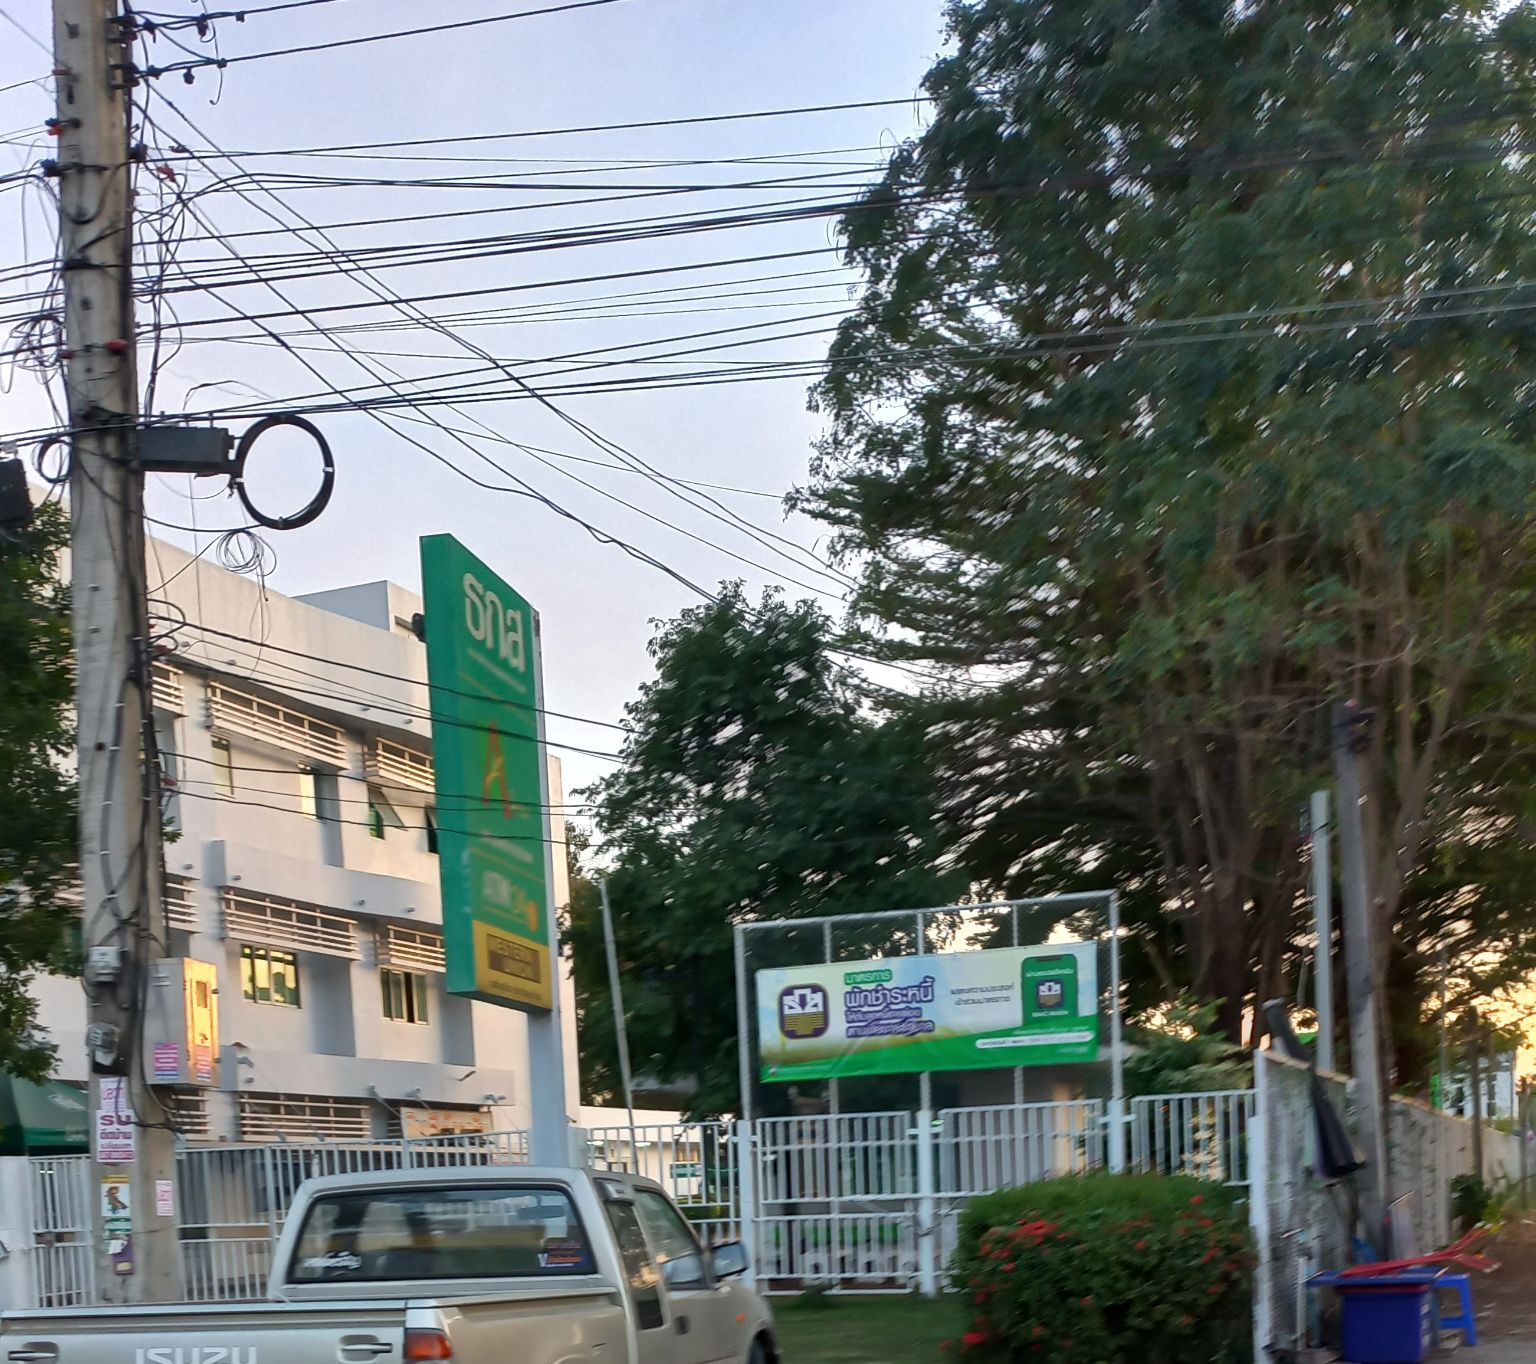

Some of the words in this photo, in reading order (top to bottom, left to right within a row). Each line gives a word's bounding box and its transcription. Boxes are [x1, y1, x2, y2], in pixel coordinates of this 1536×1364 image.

[846, 976, 934, 1007] พักชำระหนี้
